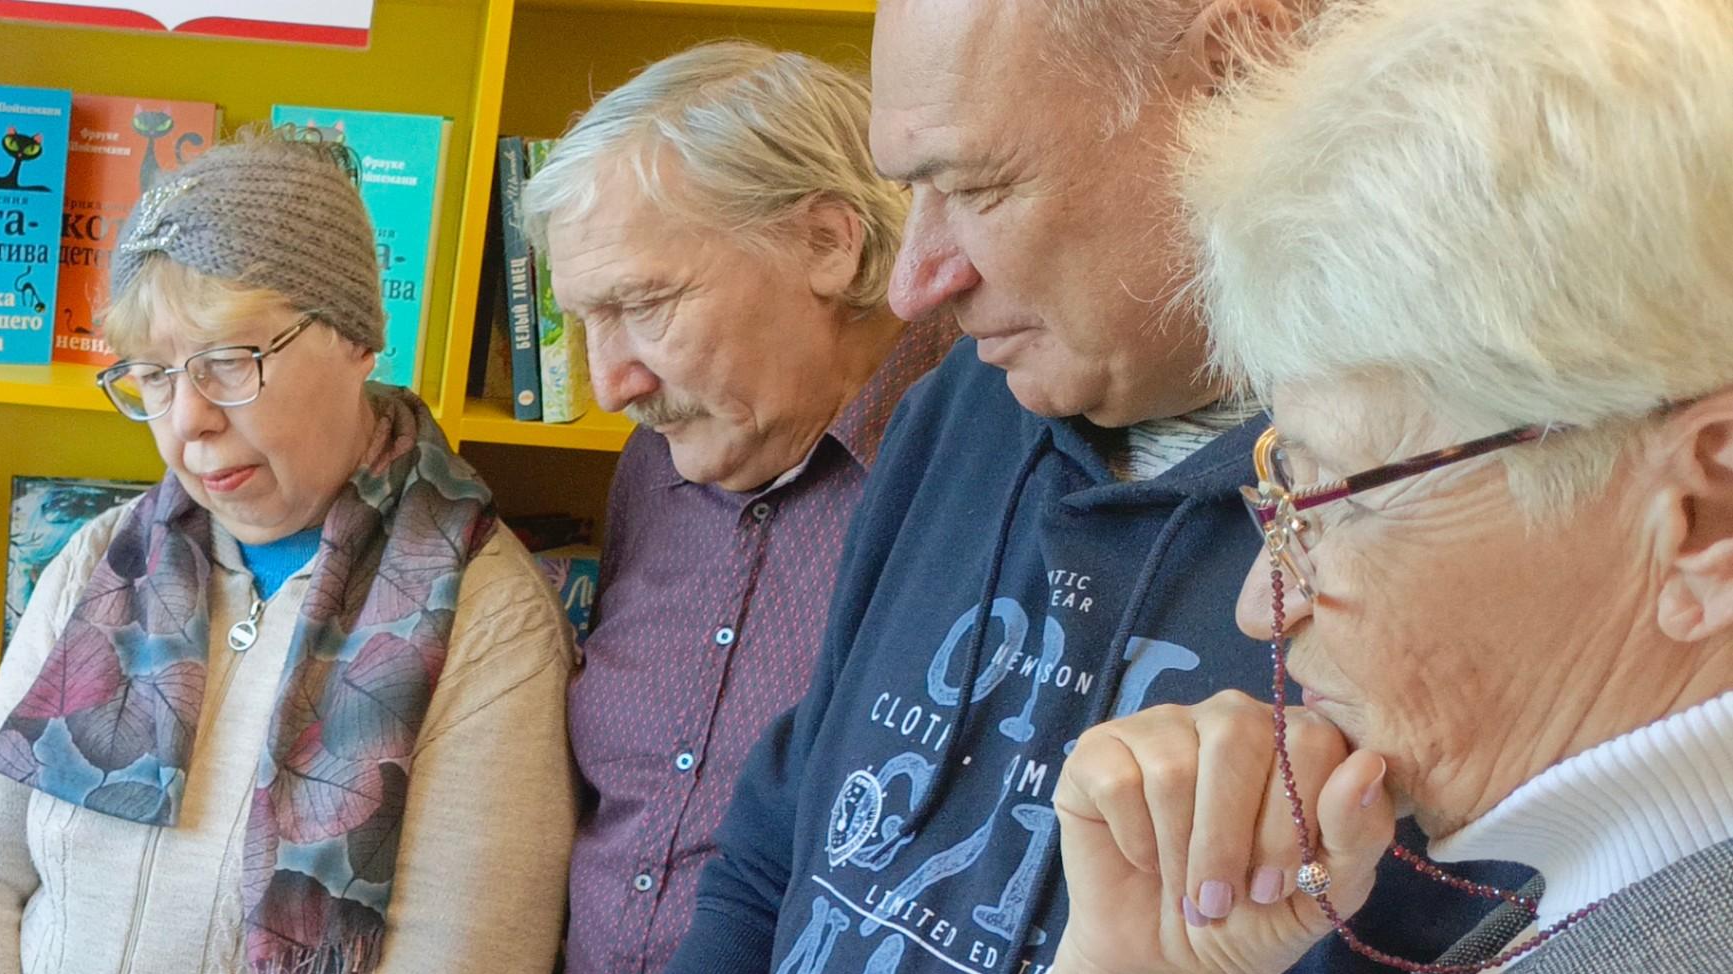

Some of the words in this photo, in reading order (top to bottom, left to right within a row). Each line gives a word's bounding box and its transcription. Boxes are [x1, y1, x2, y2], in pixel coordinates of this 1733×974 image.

[80, 127, 119, 140] Фрауке
[362, 154, 406, 170] Фрауке
[510, 256, 529, 300] ТАНЕЦ
[513, 304, 531, 350] БЕЛЫЙ
[1051, 589, 1093, 613] EAR
[865, 884, 958, 948] LIMITED
